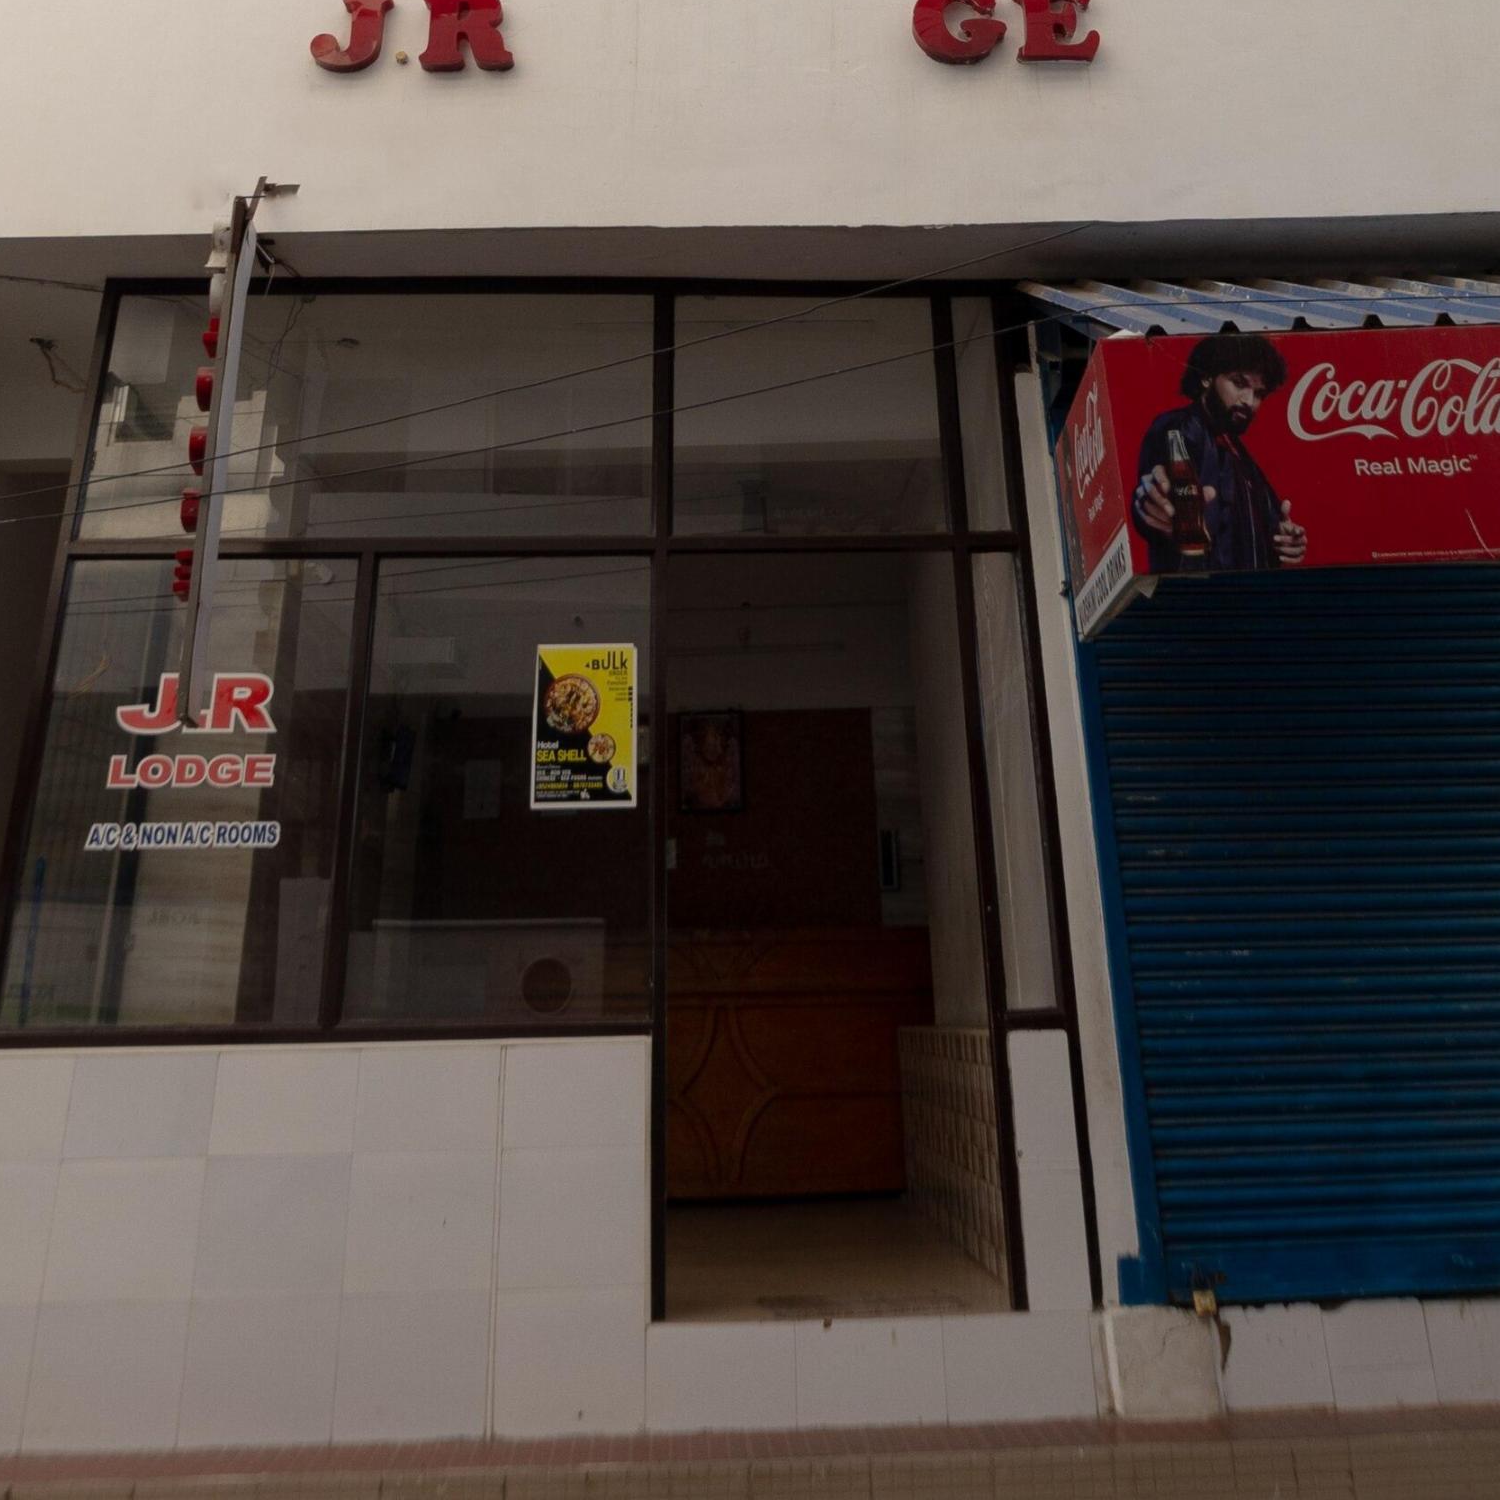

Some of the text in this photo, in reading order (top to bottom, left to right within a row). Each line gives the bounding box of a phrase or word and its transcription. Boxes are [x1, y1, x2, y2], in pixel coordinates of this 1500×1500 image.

[1354, 457, 1402, 476] Real
[537, 740, 559, 749] Hotel
[536, 749, 587, 762] SEA SHELL
[106, 754, 277, 789] LODGE
[87, 821, 279, 847] A/C & NON A/C ROOMS
